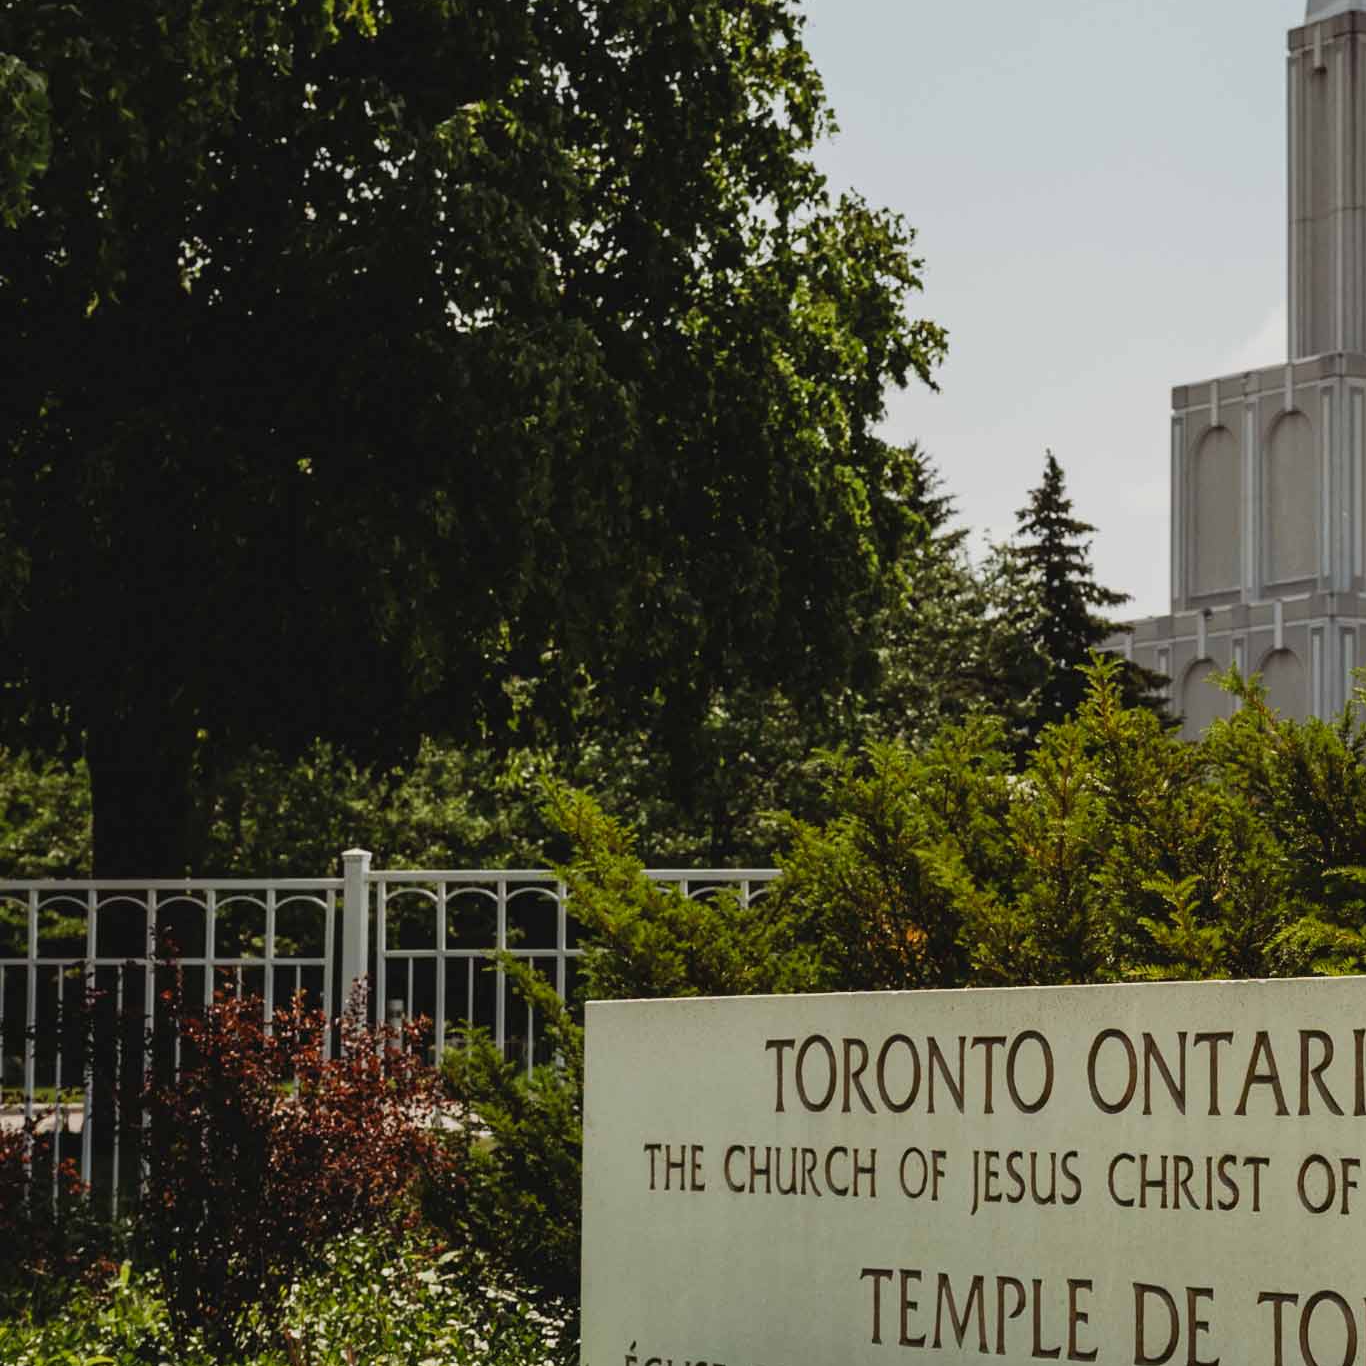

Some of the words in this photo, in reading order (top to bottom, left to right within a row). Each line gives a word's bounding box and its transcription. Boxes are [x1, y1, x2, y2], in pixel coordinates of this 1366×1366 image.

[765, 1032, 1055, 1115] TORONTO
[643, 1143, 705, 1191] THE
[724, 1145, 877, 1197] CHURCH
[899, 1147, 947, 1201] OF
[971, 1150, 1082, 1215] JESUS
[1107, 1153, 1269, 1213] CHRIST
[1297, 1153, 1360, 1215] OF
[860, 1268, 1098, 1363] TEMPLE
